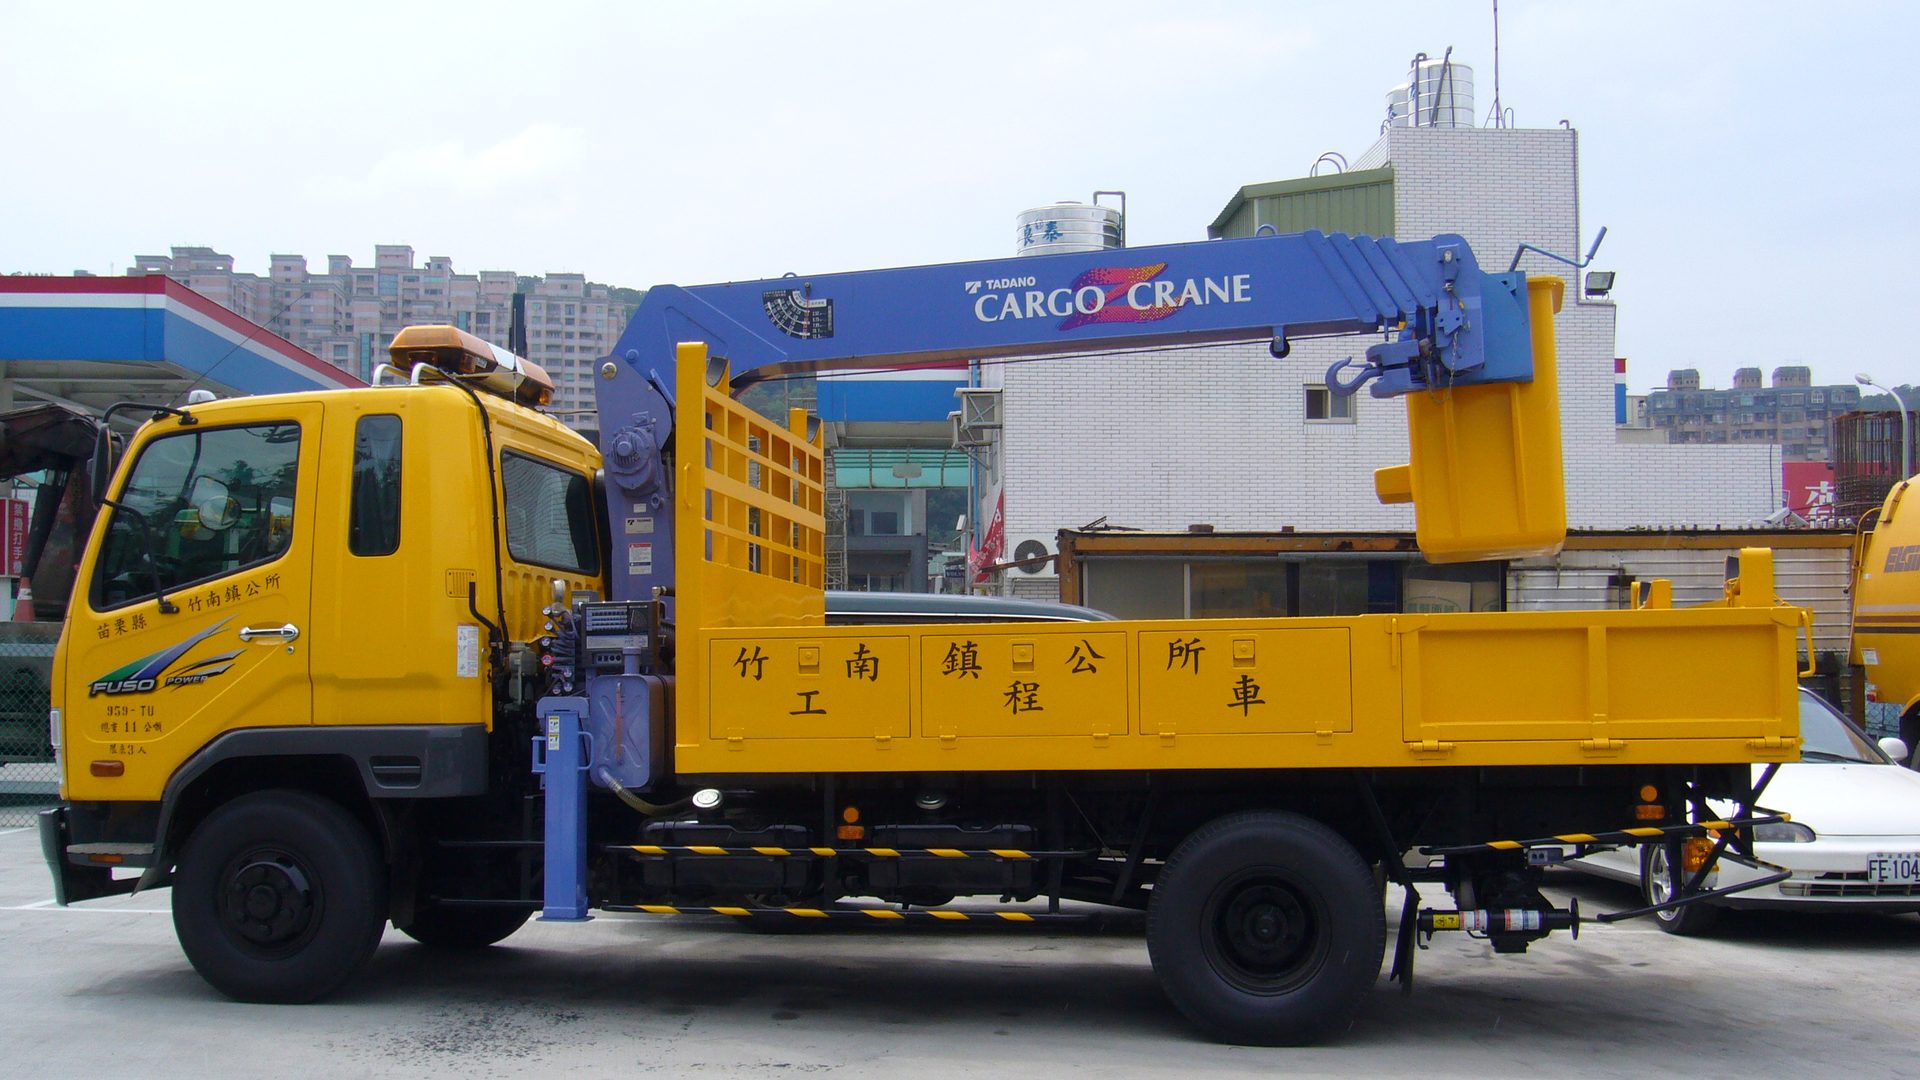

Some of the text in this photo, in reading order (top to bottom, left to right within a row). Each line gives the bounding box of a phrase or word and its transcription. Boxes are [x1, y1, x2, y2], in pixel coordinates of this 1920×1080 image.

[986, 276, 1036, 289] TADANO
[974, 286, 1106, 323] CARGO
[1127, 274, 1252, 310] CRANE
[96, 573, 281, 640] 苗栗縣 竹南鎮公所
[90, 675, 208, 696] FUSO POWER
[125, 721, 137, 733] 11
